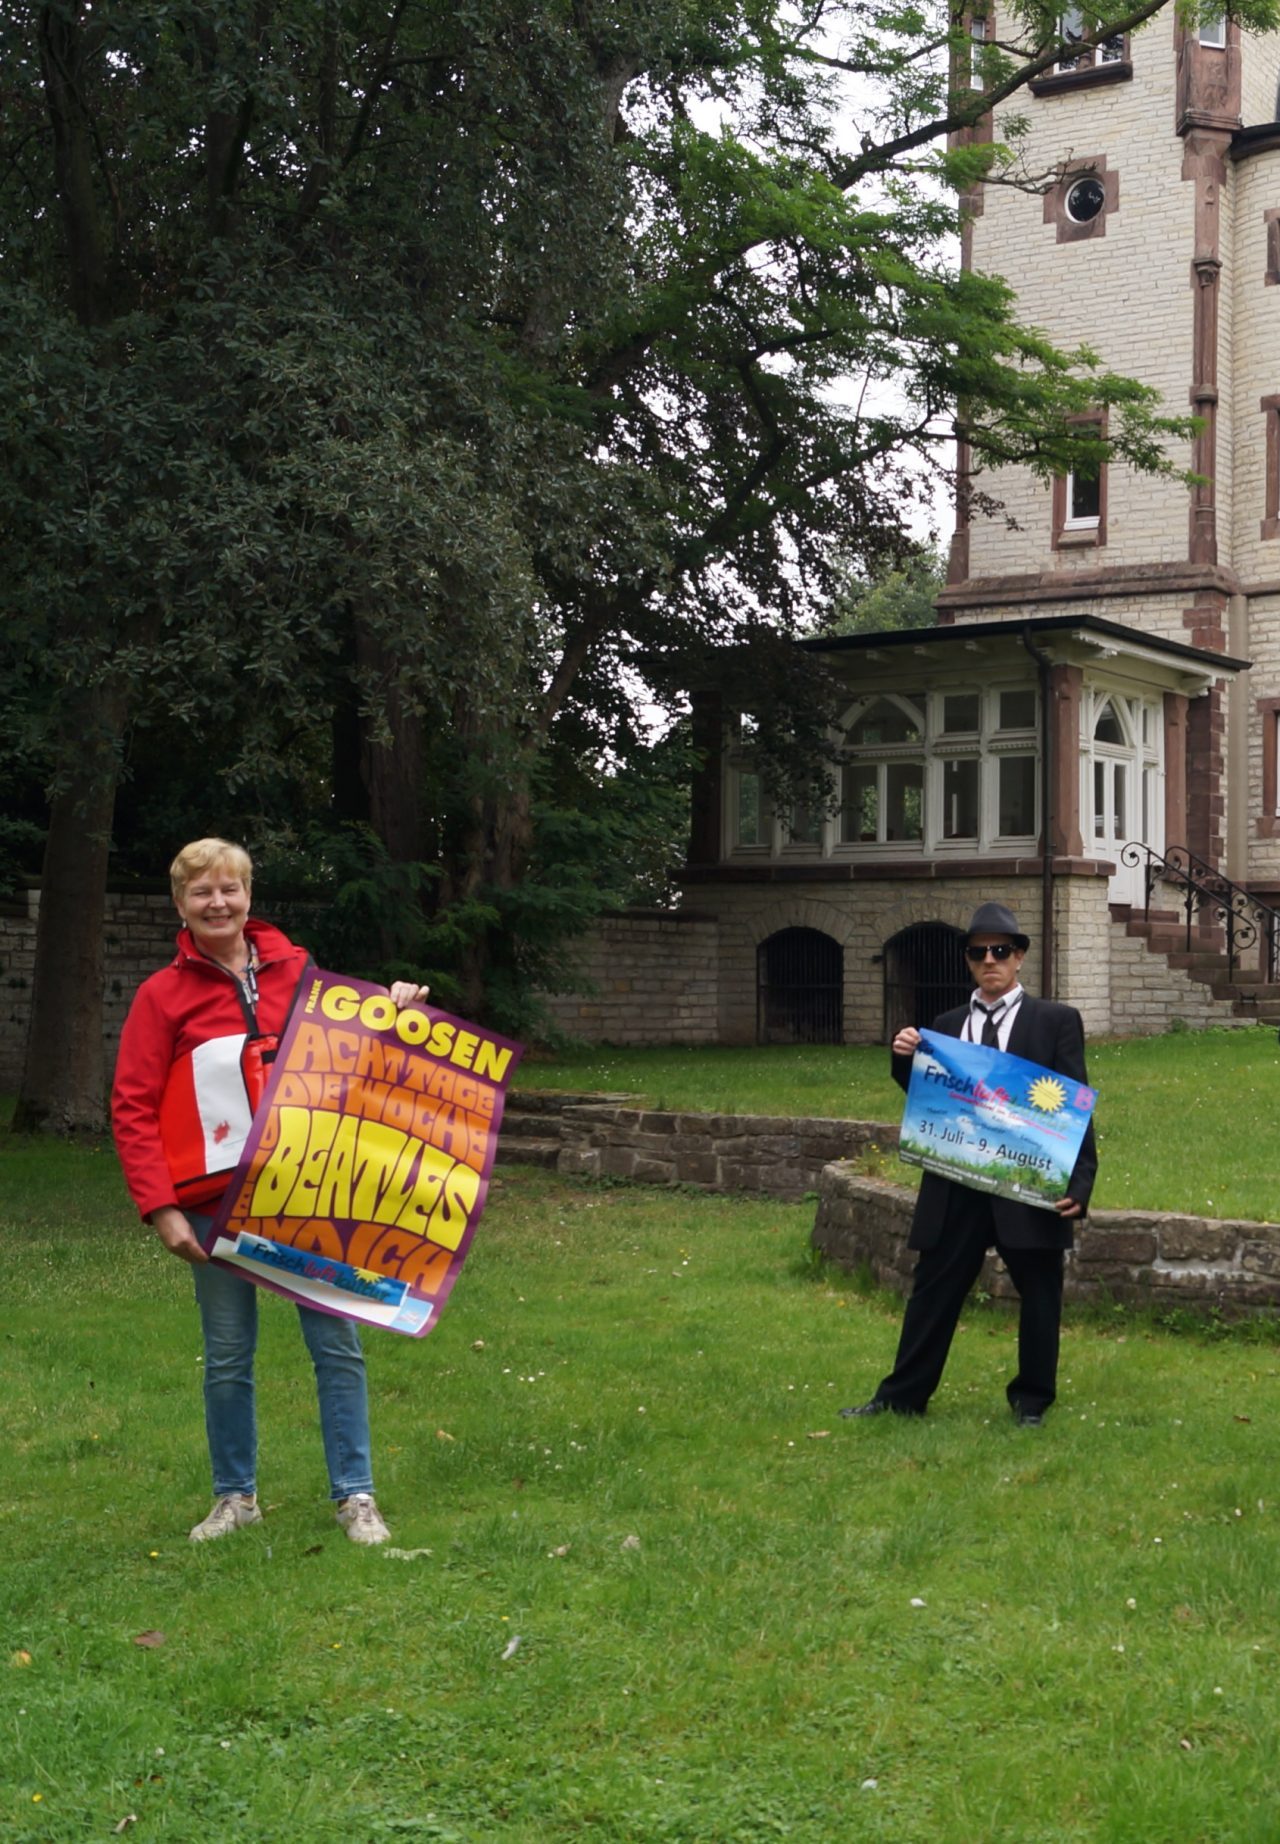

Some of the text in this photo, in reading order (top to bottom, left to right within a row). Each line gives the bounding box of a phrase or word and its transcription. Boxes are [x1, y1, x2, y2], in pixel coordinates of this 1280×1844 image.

[304, 979, 323, 1014] FRANK
[321, 985, 513, 1082] GOOSEN
[284, 1021, 496, 1120] ACHT TAGE
[273, 1072, 491, 1174] DIE WOCHE
[919, 1120, 937, 1137] 31.
[941, 1127, 965, 1145] Juli
[977, 1138, 991, 1153] 9.
[996, 1144, 1053, 1171] August
[250, 1106, 480, 1251] BEATLES
[348, 1223, 454, 1295] ICH
